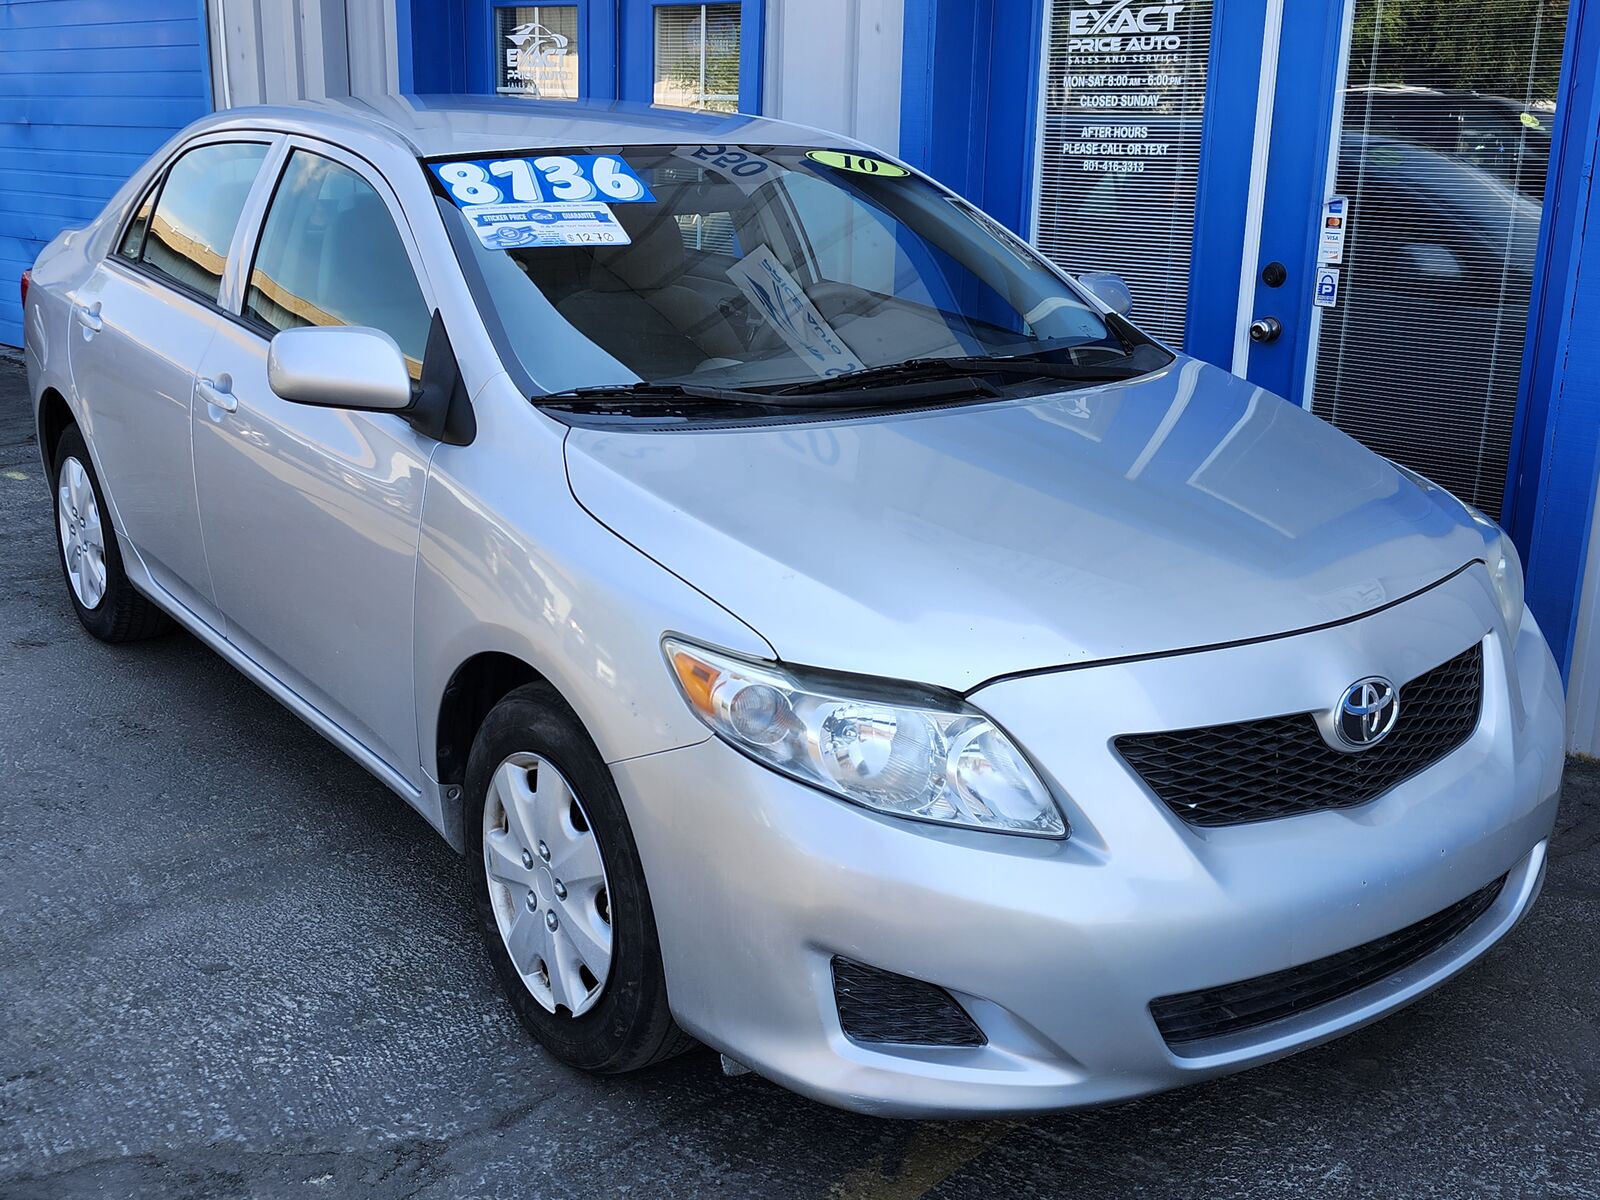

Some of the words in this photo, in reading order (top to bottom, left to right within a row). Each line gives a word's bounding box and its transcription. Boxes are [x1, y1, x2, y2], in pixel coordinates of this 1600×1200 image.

[1069, 5, 1185, 35] EXACT
[1068, 37, 1122, 52] PRICE
[1125, 35, 1181, 51] AUTO
[506, 48, 568, 67] EXACT
[1068, 55, 1100, 64] SALES
[1104, 54, 1127, 64] AND
[1132, 53, 1179, 63] SERVICE
[1063, 76, 1106, 87] MON-SAT
[1107, 75, 1128, 86] 8:00
[1129, 77, 1141, 86] AM
[1147, 74, 1168, 86] 6:00
[1170, 76, 1182, 85] PM
[1080, 95, 1118, 107] CLOSED
[1120, 95, 1160, 106] SUNDAY
[1081, 127, 1112, 137] AFTER
[1113, 127, 1148, 138] HOURS
[1063, 143, 1099, 154] PLEASE
[1100, 144, 1125, 155] CALL
[1127, 144, 1142, 155] OR
[1144, 144, 1170, 155] TEXT
[842, 154, 879, 173] 10
[1083, 161, 1144, 172] 801-416-3313
[438, 156, 645, 204] 8736
[483, 214, 509, 222] STICKER
[509, 213, 527, 221] PRICE
[562, 212, 596, 220] GUARANTEE
